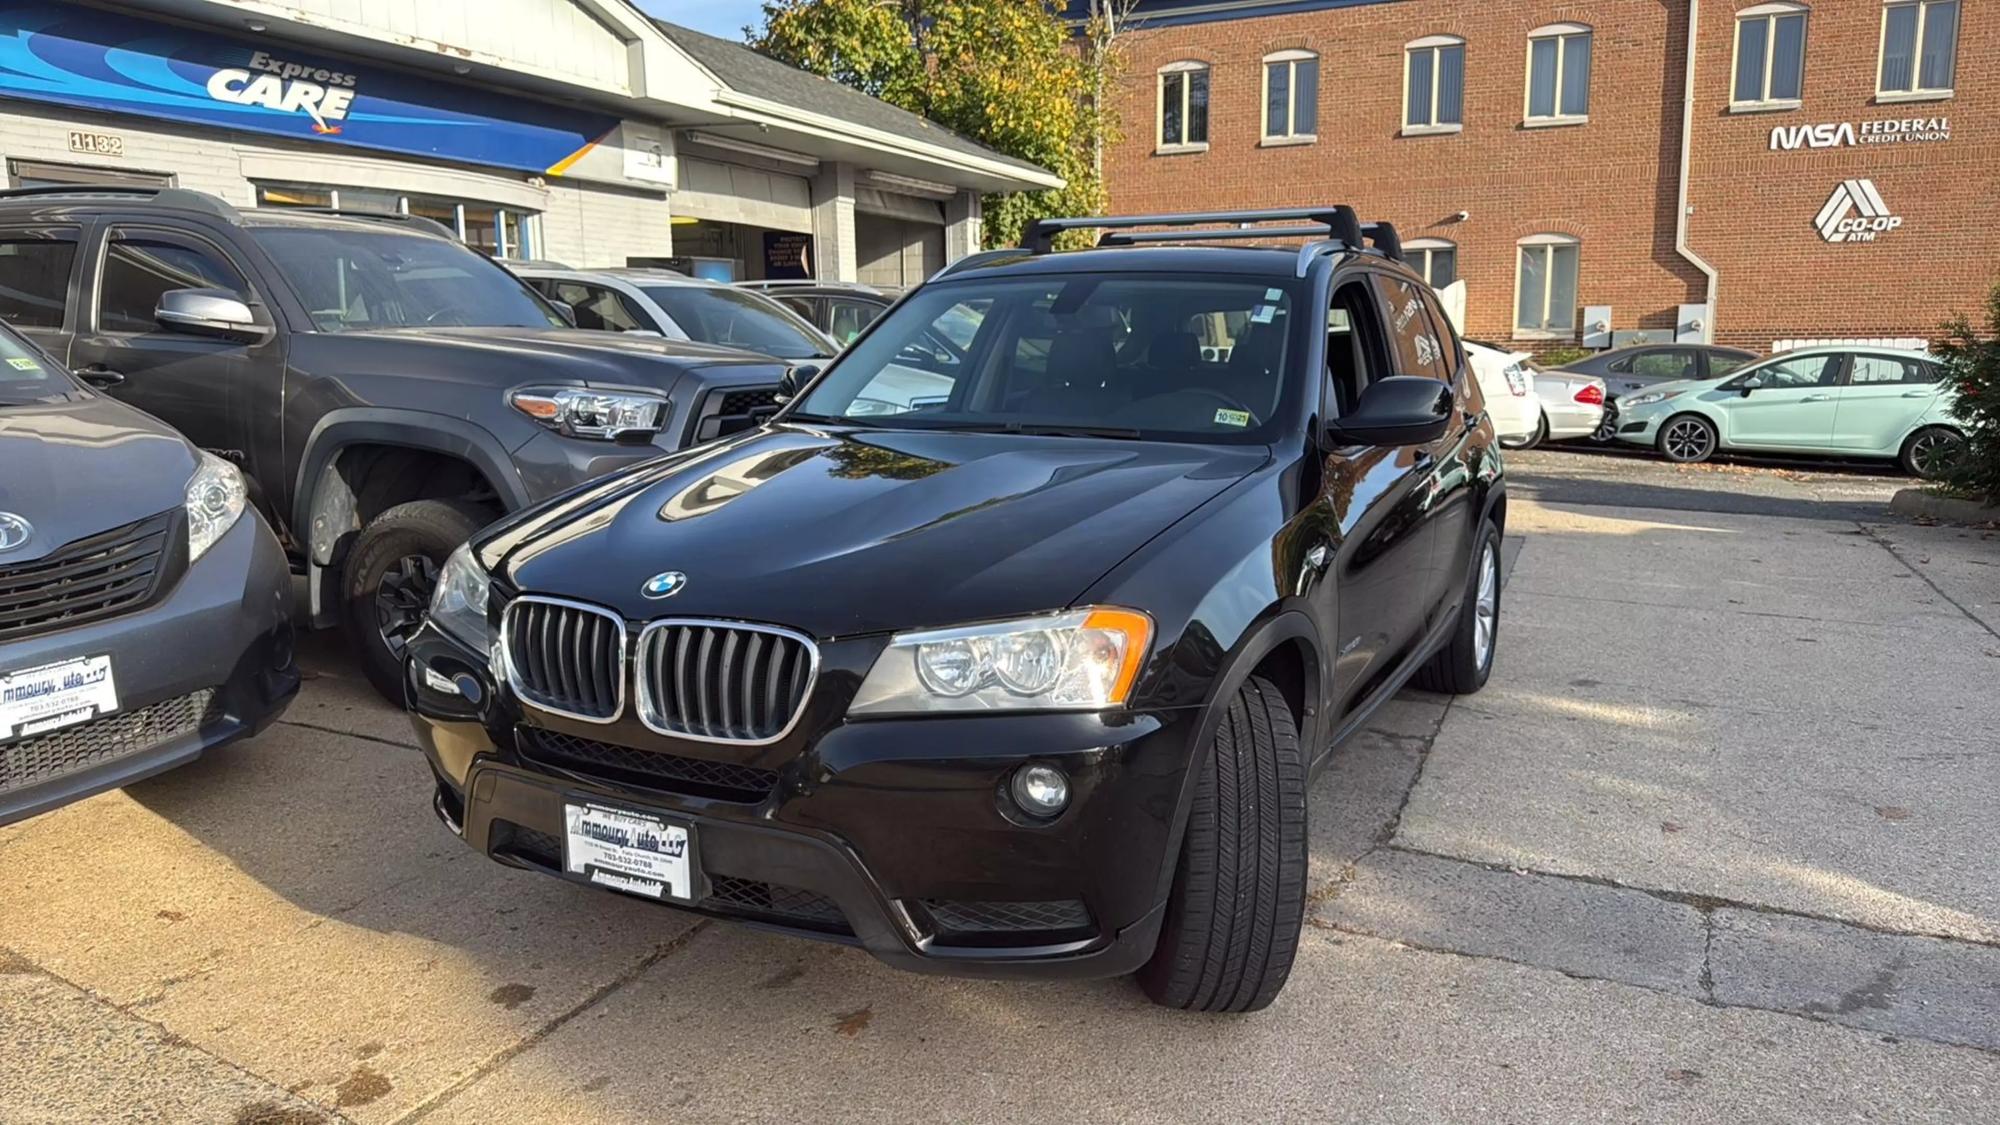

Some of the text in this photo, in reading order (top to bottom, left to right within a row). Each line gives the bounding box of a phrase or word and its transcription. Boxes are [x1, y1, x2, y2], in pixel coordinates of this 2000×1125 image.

[249, 51, 357, 86] Express
[207, 68, 355, 131] CARE
[1861, 118, 1950, 134] FEDERAL
[71, 132, 123, 154] 1132
[1770, 122, 1856, 150] NASA
[1859, 131, 1950, 144] CREDIT UNION
[1838, 216, 1902, 232] CO-OP
[1847, 232, 1876, 242] ATM
[1218, 412, 1228, 421] 10
[603, 852, 653, 869] 703-532-0788
